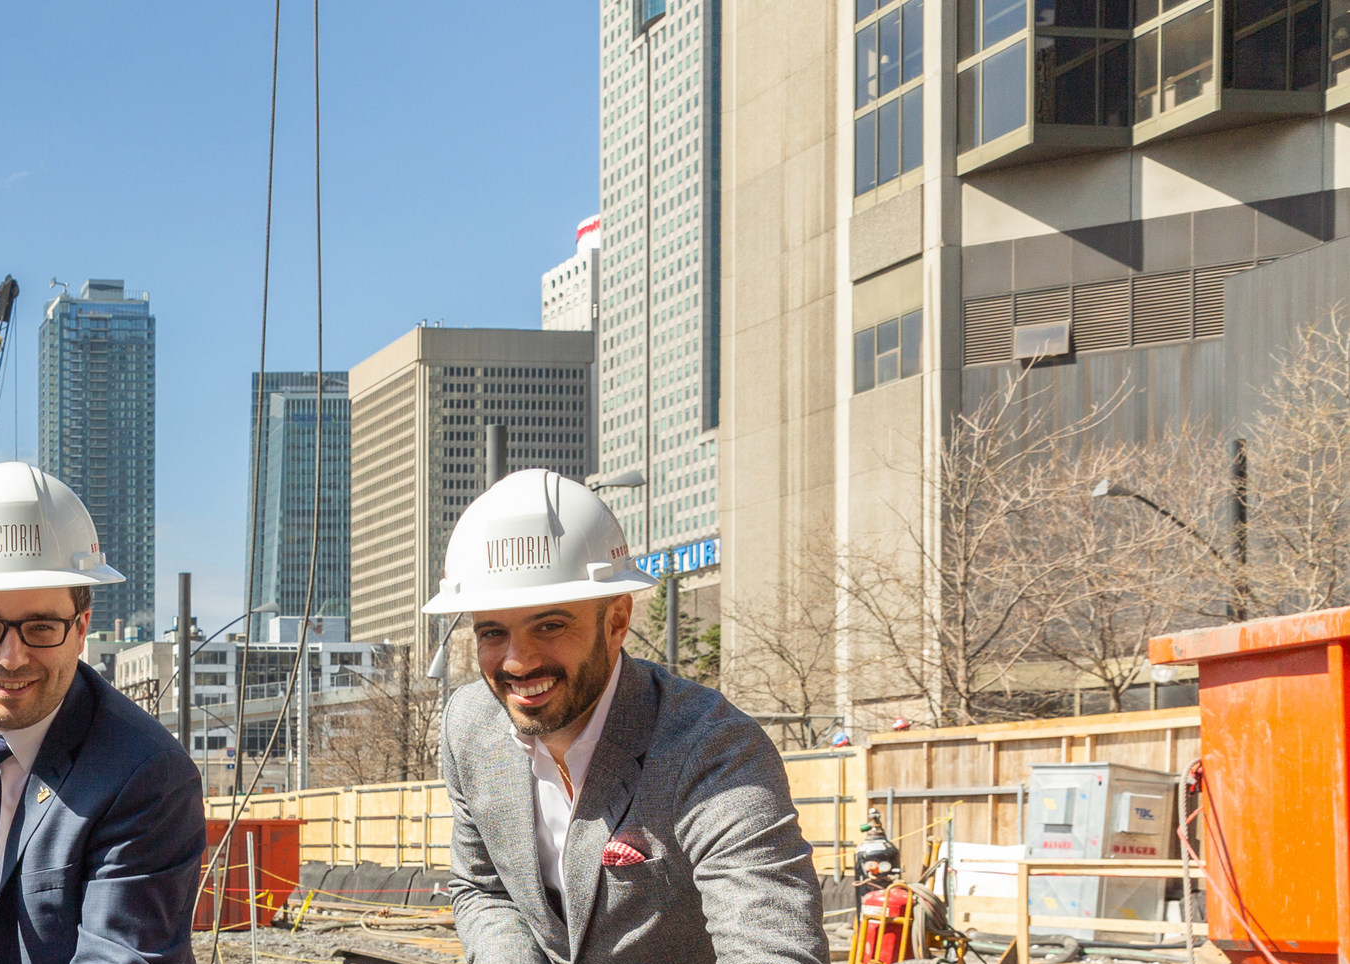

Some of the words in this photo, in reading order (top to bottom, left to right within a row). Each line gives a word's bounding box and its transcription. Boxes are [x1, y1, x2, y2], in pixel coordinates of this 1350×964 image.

[487, 535, 551, 569] VICTORIA
[1043, 840, 1073, 850] DANGER
[1113, 845, 1157, 856] DANGER
